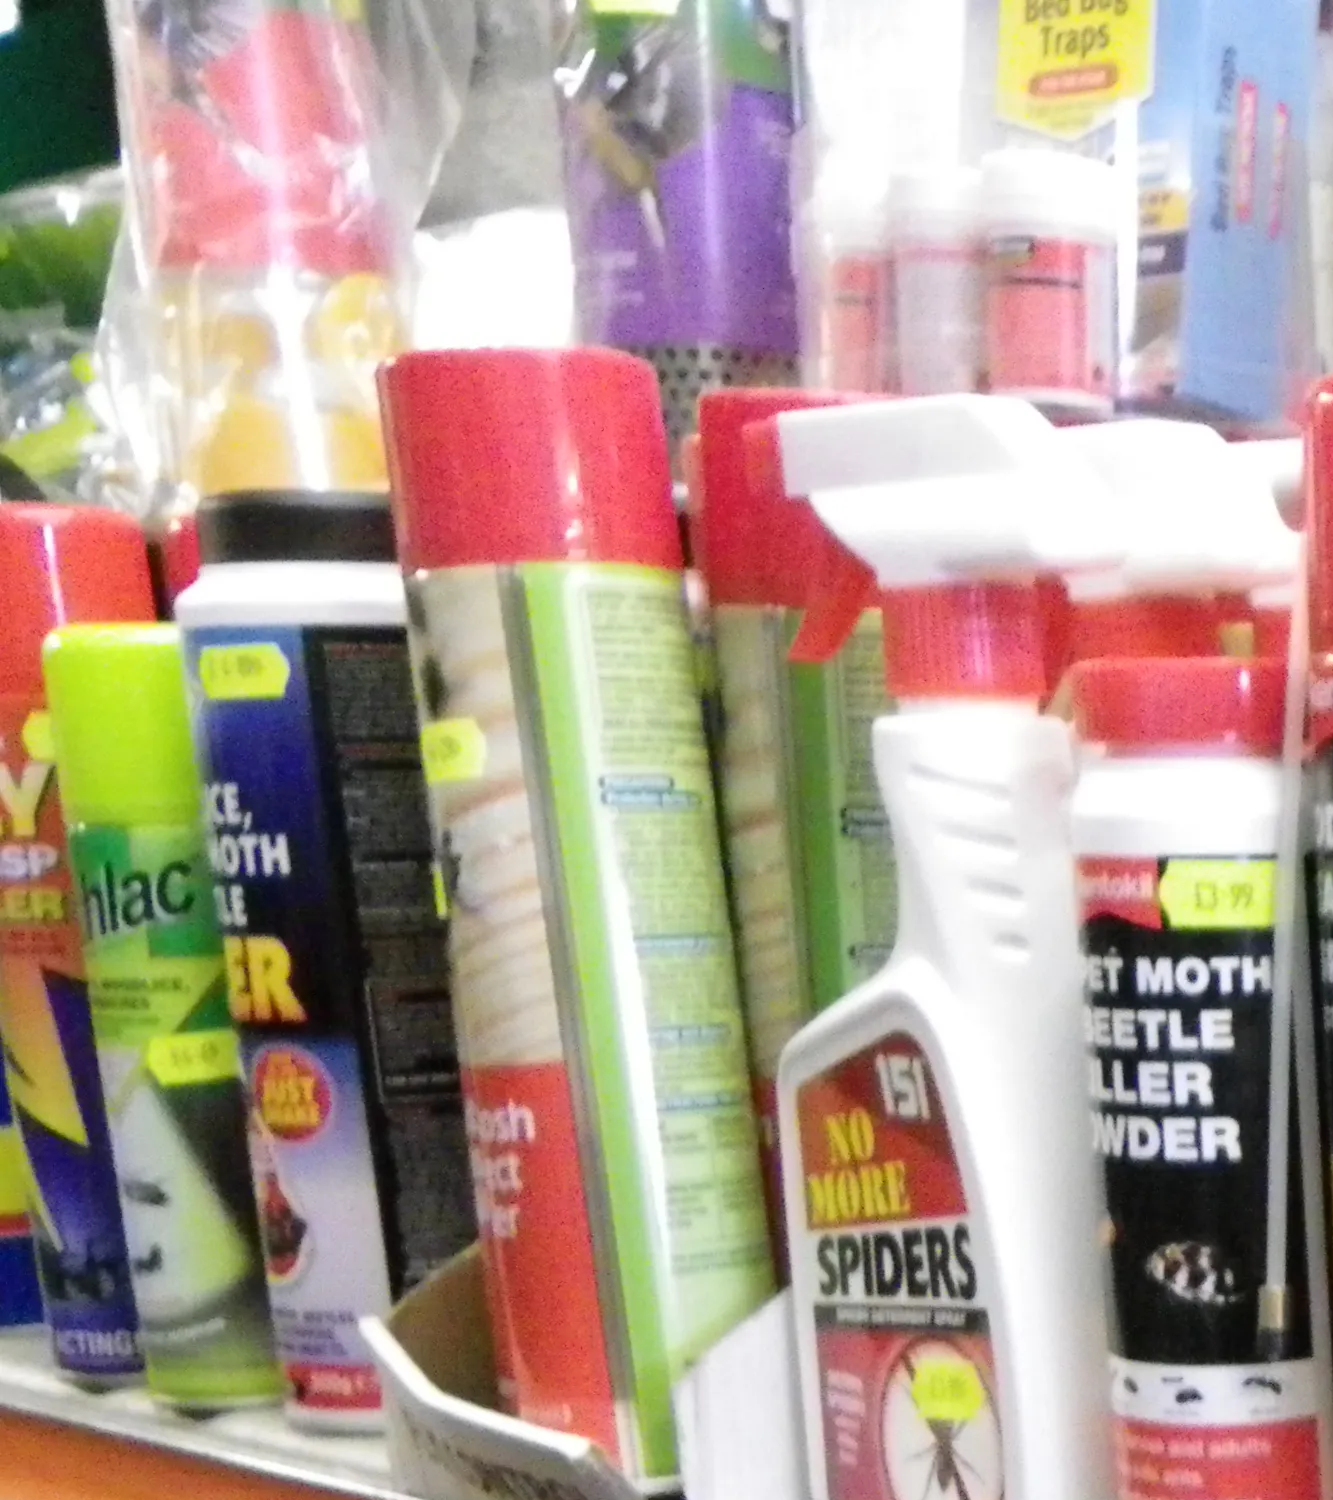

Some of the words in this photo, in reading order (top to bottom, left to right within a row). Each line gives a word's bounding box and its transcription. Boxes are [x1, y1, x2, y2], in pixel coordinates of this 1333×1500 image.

[1040, 24, 1111, 58] Traps
[1134, 955, 1273, 998] MOTH
[1086, 1007, 1236, 1052] EETLE
[824, 1106, 878, 1164] NO
[1091, 1113, 1243, 1165] WDER
[806, 1161, 913, 1224] MORE
[816, 1223, 978, 1302] SPIDERS
